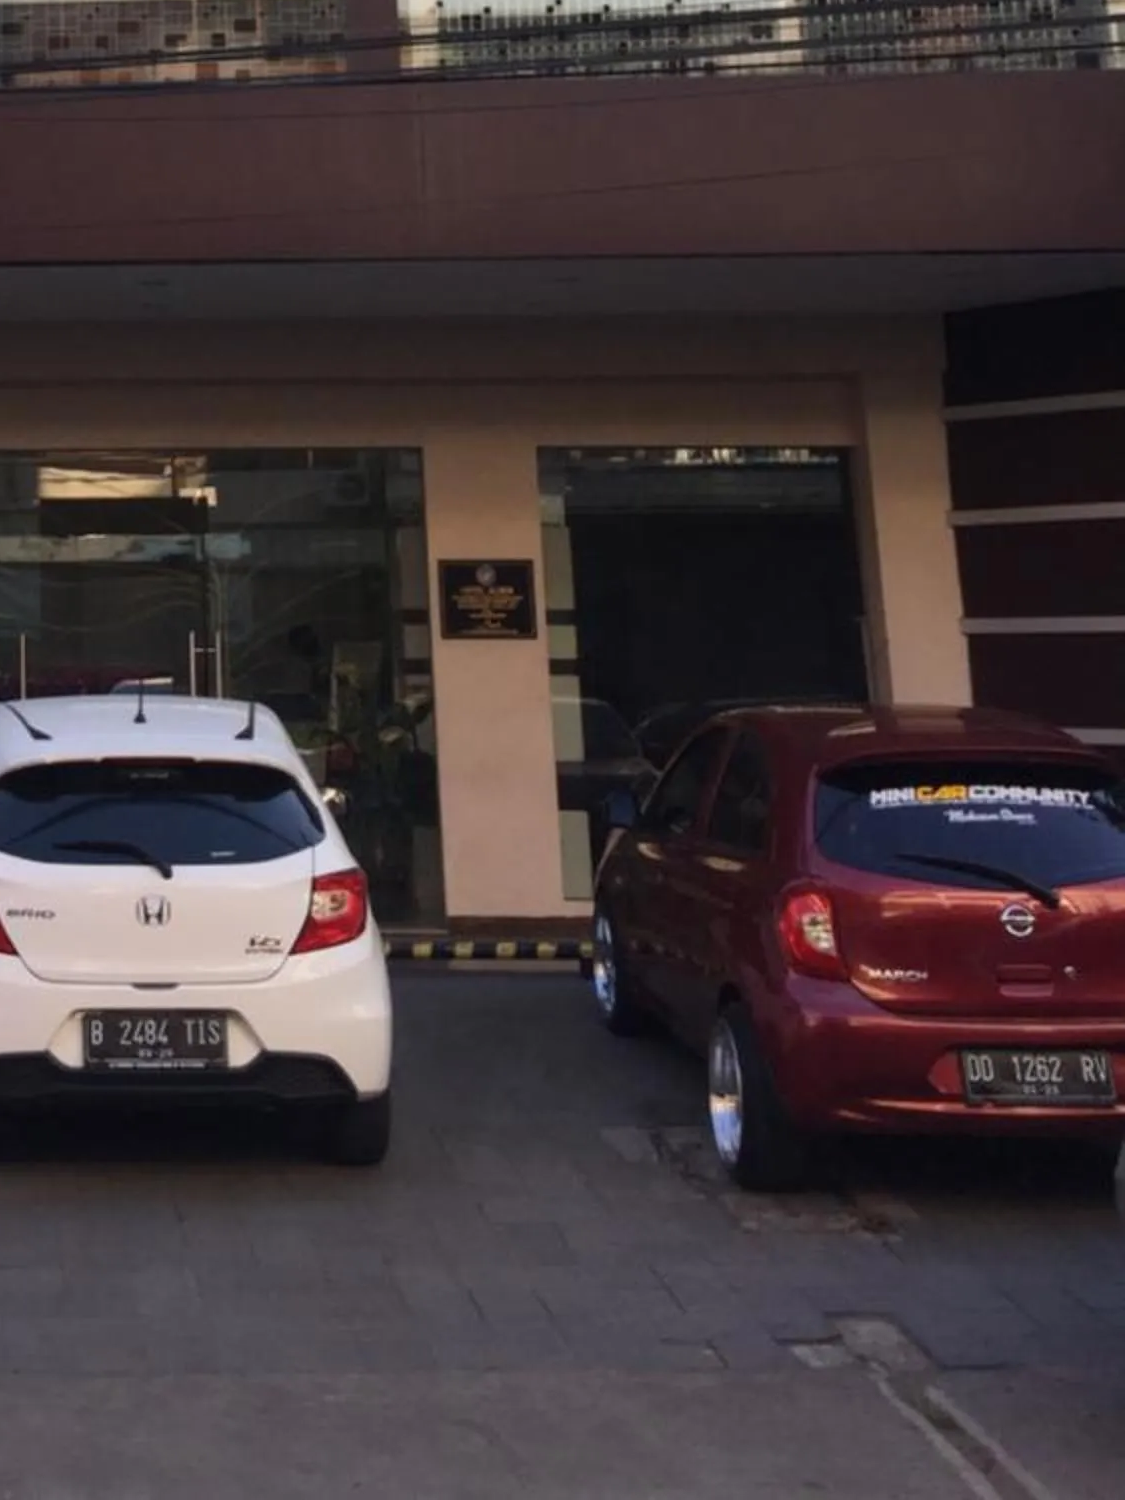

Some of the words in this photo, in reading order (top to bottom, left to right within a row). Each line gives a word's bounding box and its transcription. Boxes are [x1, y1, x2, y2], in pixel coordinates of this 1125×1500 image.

[870, 789, 915, 806] MINI
[916, 784, 969, 803] CAR
[969, 784, 1091, 805] COMMUNITY
[868, 968, 928, 982] MARCH
[90, 1019, 103, 1045] B
[119, 1019, 169, 1045] 2484
[183, 1019, 220, 1045] TIS
[1011, 1056, 1063, 1082] 1262
